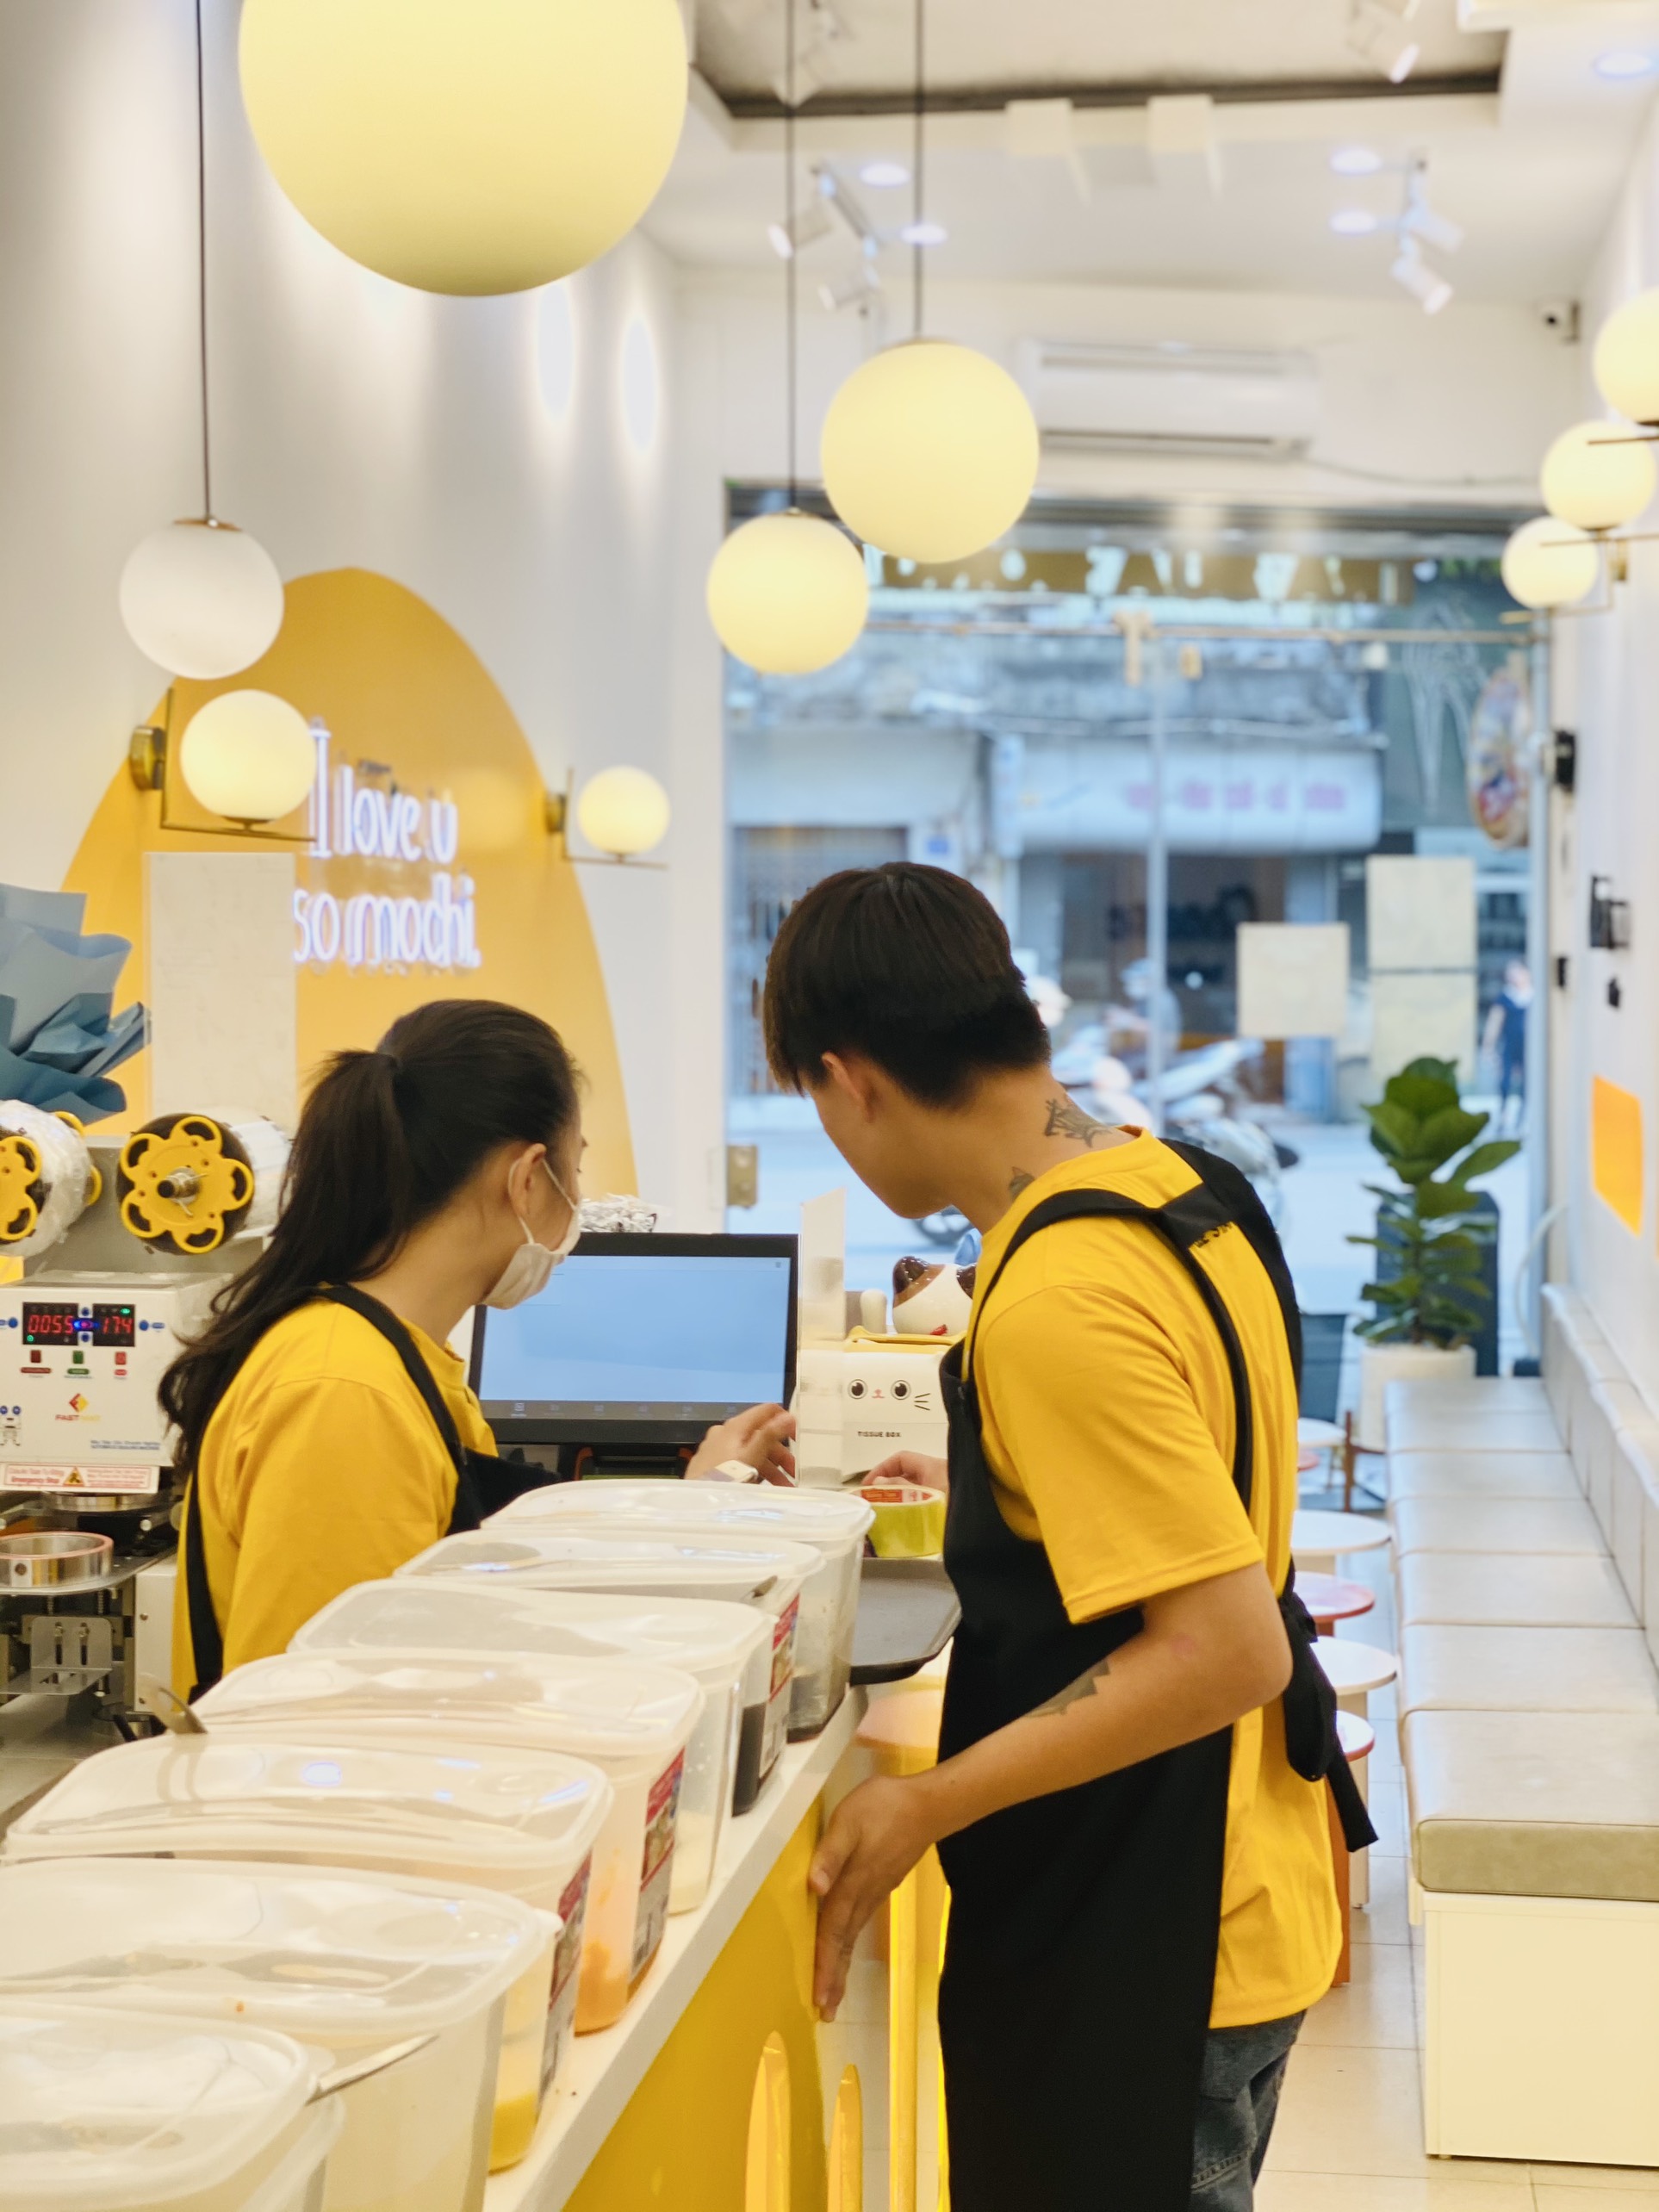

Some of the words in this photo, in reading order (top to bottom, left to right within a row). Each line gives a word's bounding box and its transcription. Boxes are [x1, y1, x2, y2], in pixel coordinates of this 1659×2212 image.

[308, 729, 332, 857] I
[335, 763, 421, 861] love
[293, 889, 340, 963] so
[346, 870, 482, 969] mochi
[28, 1314, 75, 1335] 0055
[103, 1315, 134, 1334] 174
